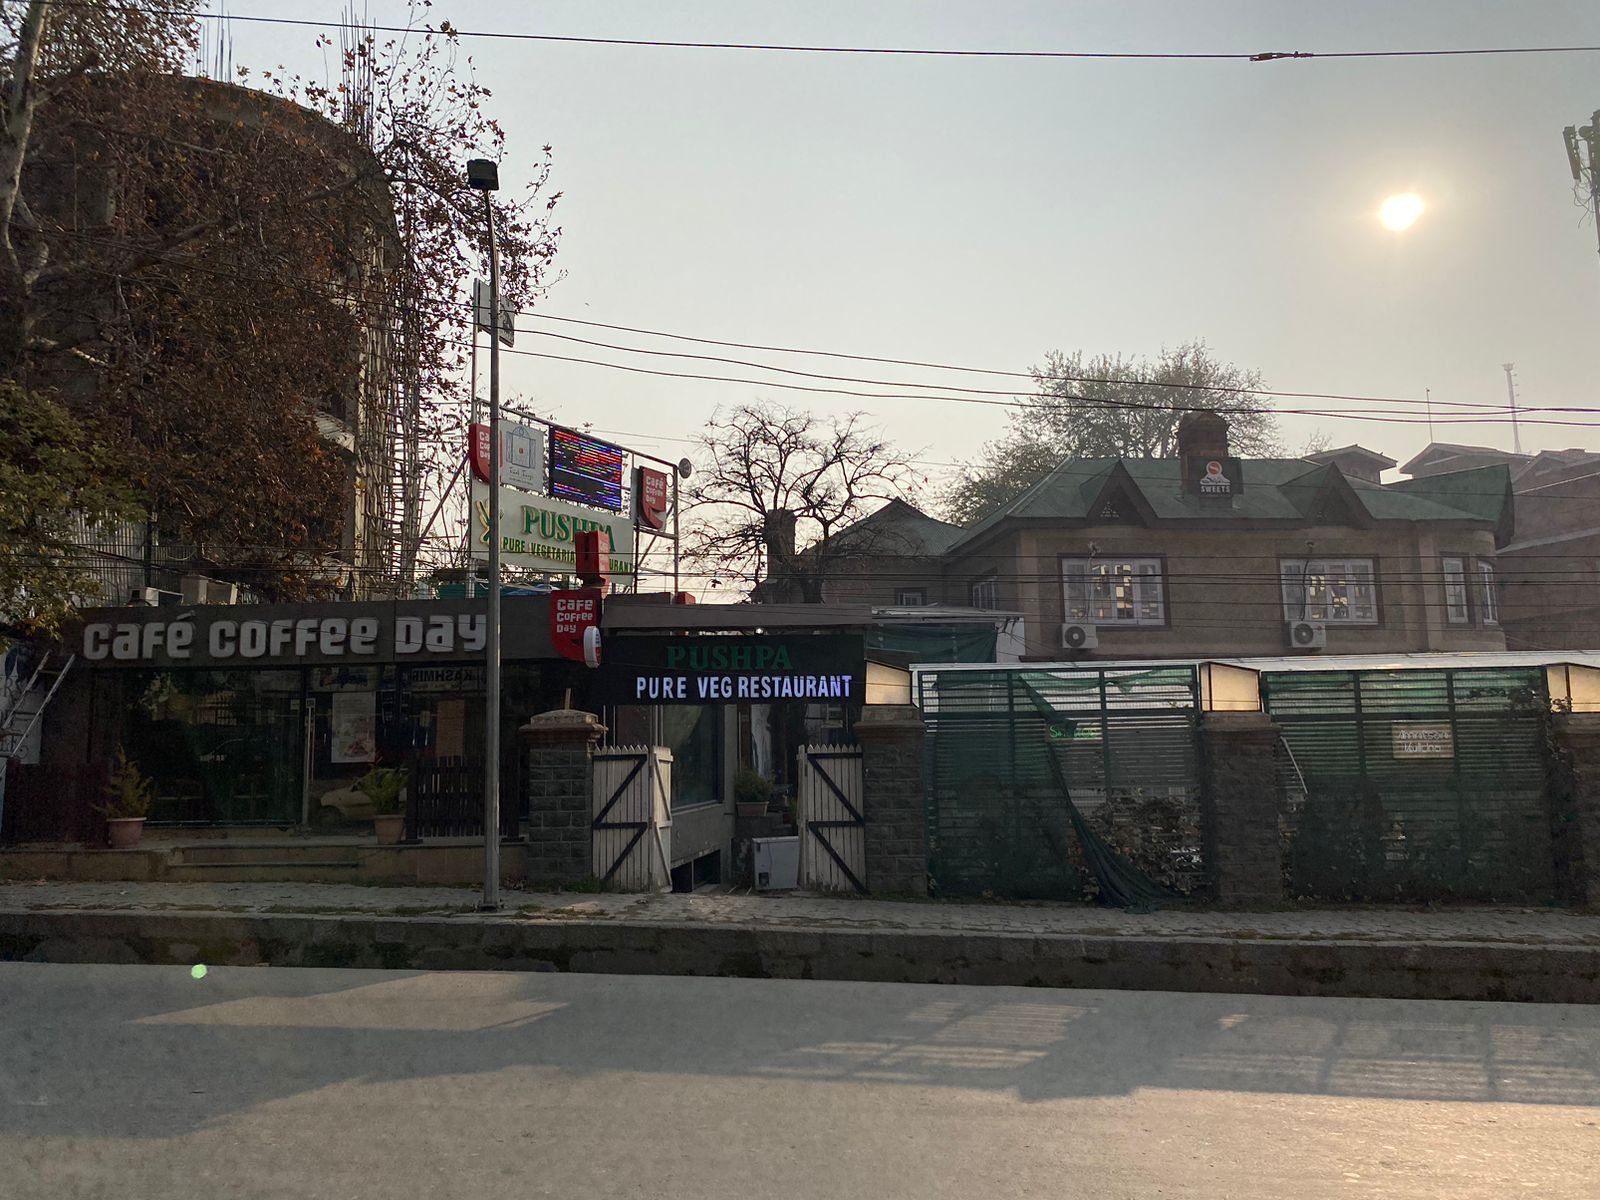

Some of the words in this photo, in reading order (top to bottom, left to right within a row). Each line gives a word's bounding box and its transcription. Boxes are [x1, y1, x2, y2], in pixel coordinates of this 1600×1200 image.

[1201, 485, 1231, 493] SWEETS
[502, 536, 526, 552] PURE
[529, 542, 576, 563] VEGETARIA
[395, 614, 487, 654] Day
[666, 644, 794, 671] PUSHPA
[636, 676, 687, 699] PURE
[697, 676, 733, 698] VEG
[738, 675, 853, 698] RESTAURANT
